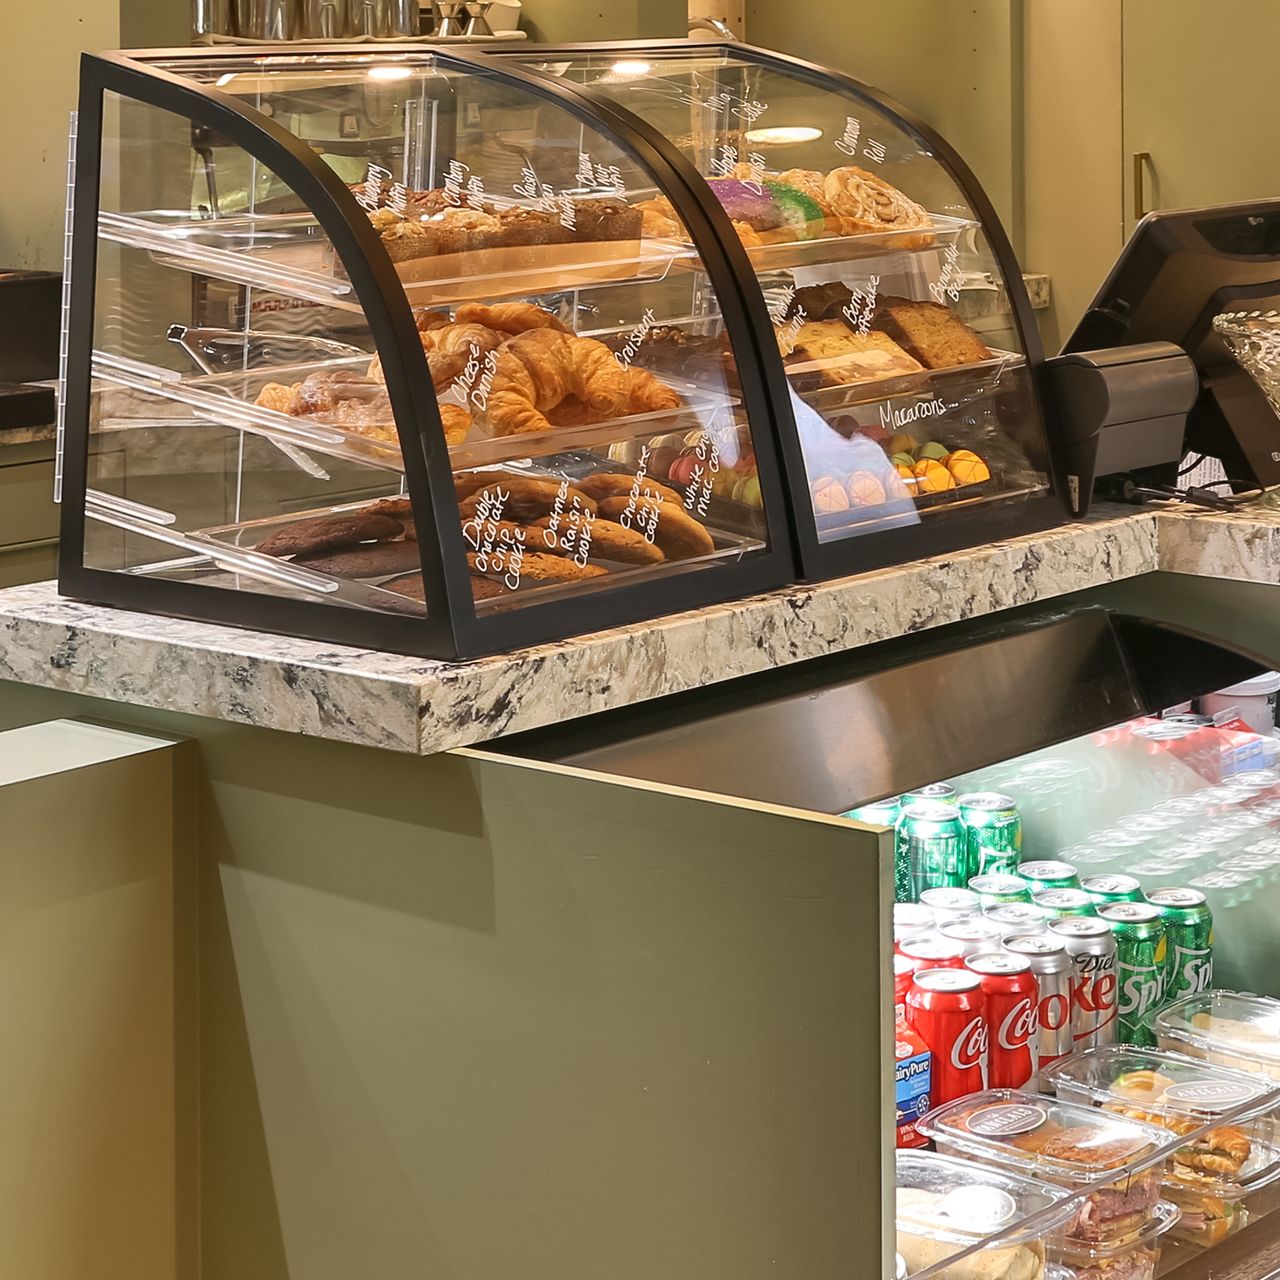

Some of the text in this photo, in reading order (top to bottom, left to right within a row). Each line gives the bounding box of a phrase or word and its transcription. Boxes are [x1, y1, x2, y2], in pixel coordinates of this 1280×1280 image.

[710, 143, 738, 177] Apple
[863, 138, 887, 164] Roll
[513, 167, 539, 201] Raisin
[741, 151, 766, 197] Danish
[842, 286, 867, 325] Berry
[614, 306, 657, 373] Croissant
[450, 342, 480, 404] Cheese
[471, 347, 501, 412] Danish
[879, 398, 947, 430] Macaroons
[462, 489, 498, 551] Double
[543, 470, 571, 549] Oatmeal
[560, 495, 582, 552] Raisin
[1074, 951, 1116, 973] Diet
[1072, 973, 1117, 1013] ke
[895, 1060, 929, 1082] airyPure
